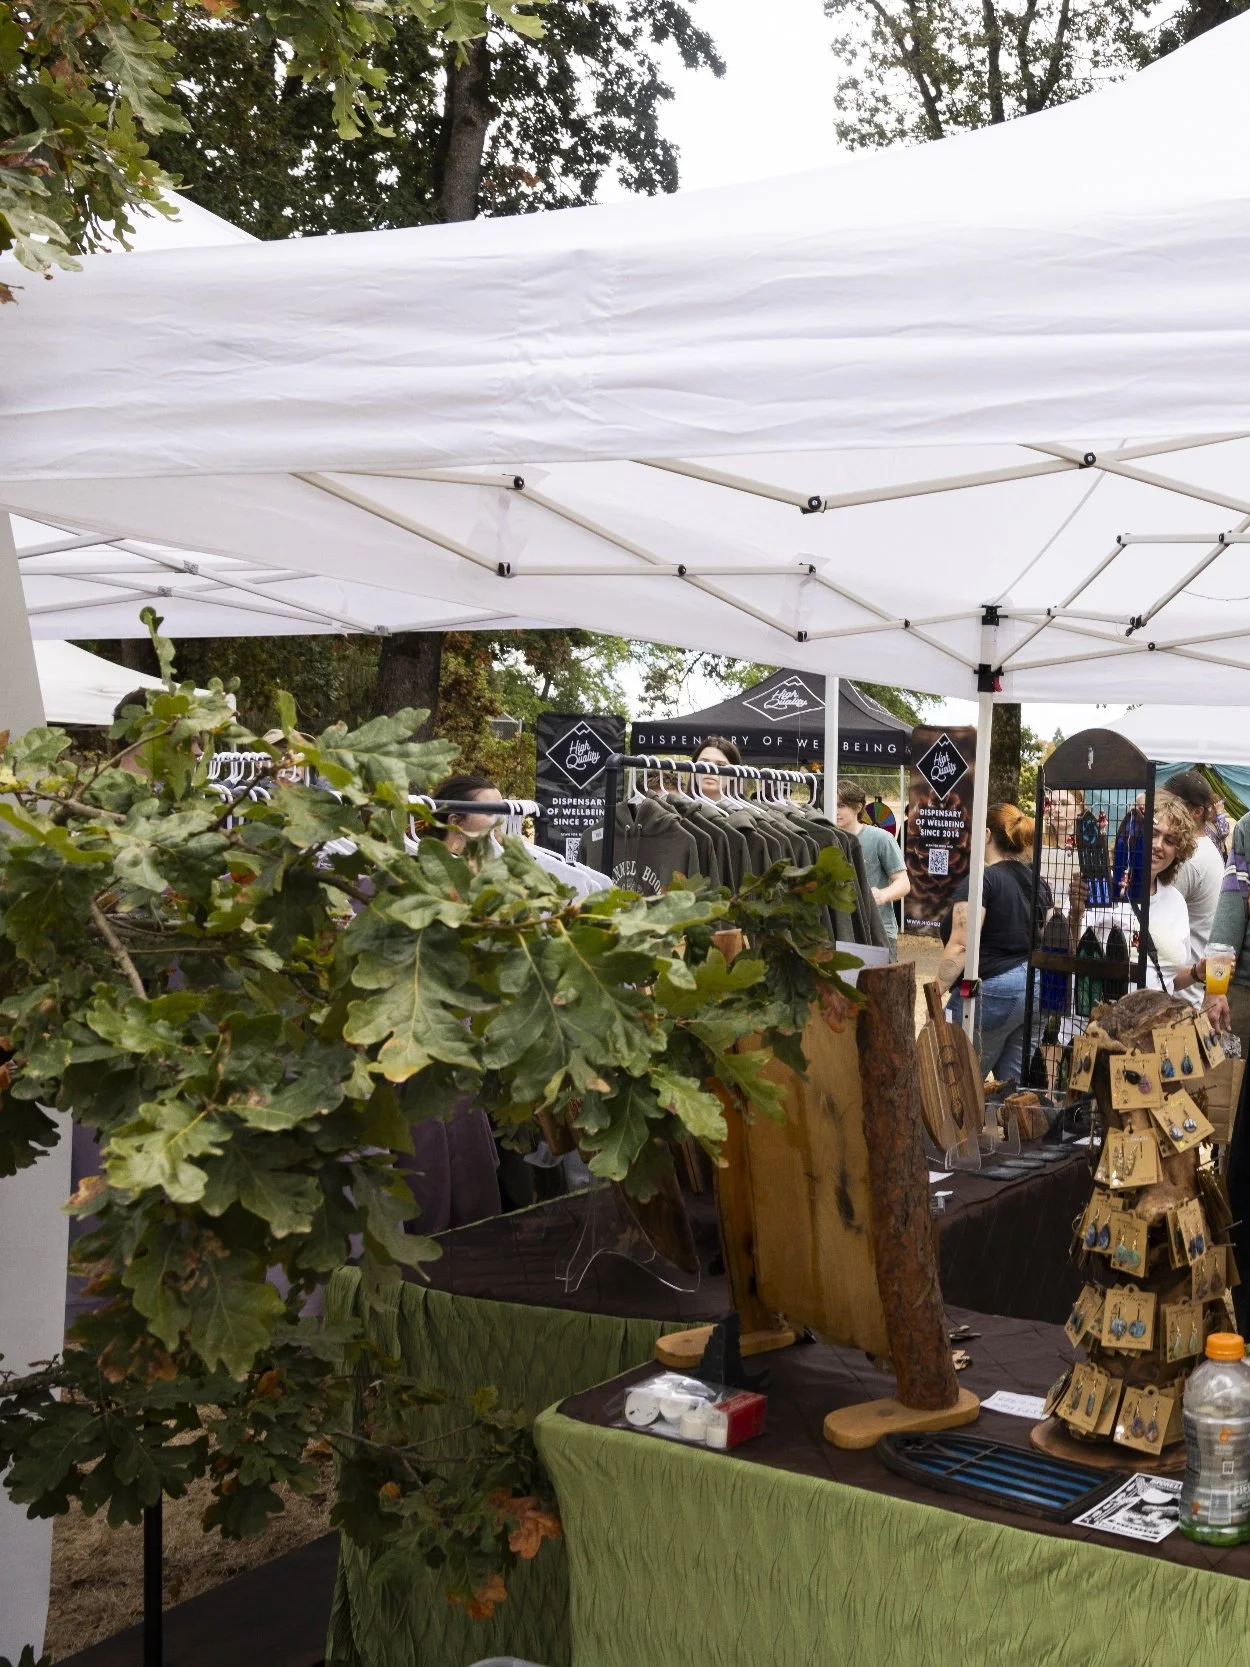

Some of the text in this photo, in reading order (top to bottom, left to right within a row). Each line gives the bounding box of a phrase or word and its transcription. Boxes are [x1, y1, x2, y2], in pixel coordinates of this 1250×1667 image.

[771, 688, 798, 700] High
[764, 697, 807, 710] Quality
[569, 739, 591, 756] High
[638, 734, 749, 745] DISPENRY
[763, 736, 783, 746] OF
[796, 738, 897, 754] WEBEING
[565, 750, 600, 771] Quality
[933, 751, 950, 767] High
[931, 762, 956, 782] Quality
[562, 808, 605, 816] WELLBEIN
[920, 808, 962, 818] DISPENSARY
[553, 818, 580, 826] SINCE
[927, 819, 965, 829] WELLBEING
[920, 829, 960, 838] SINCE 2014
